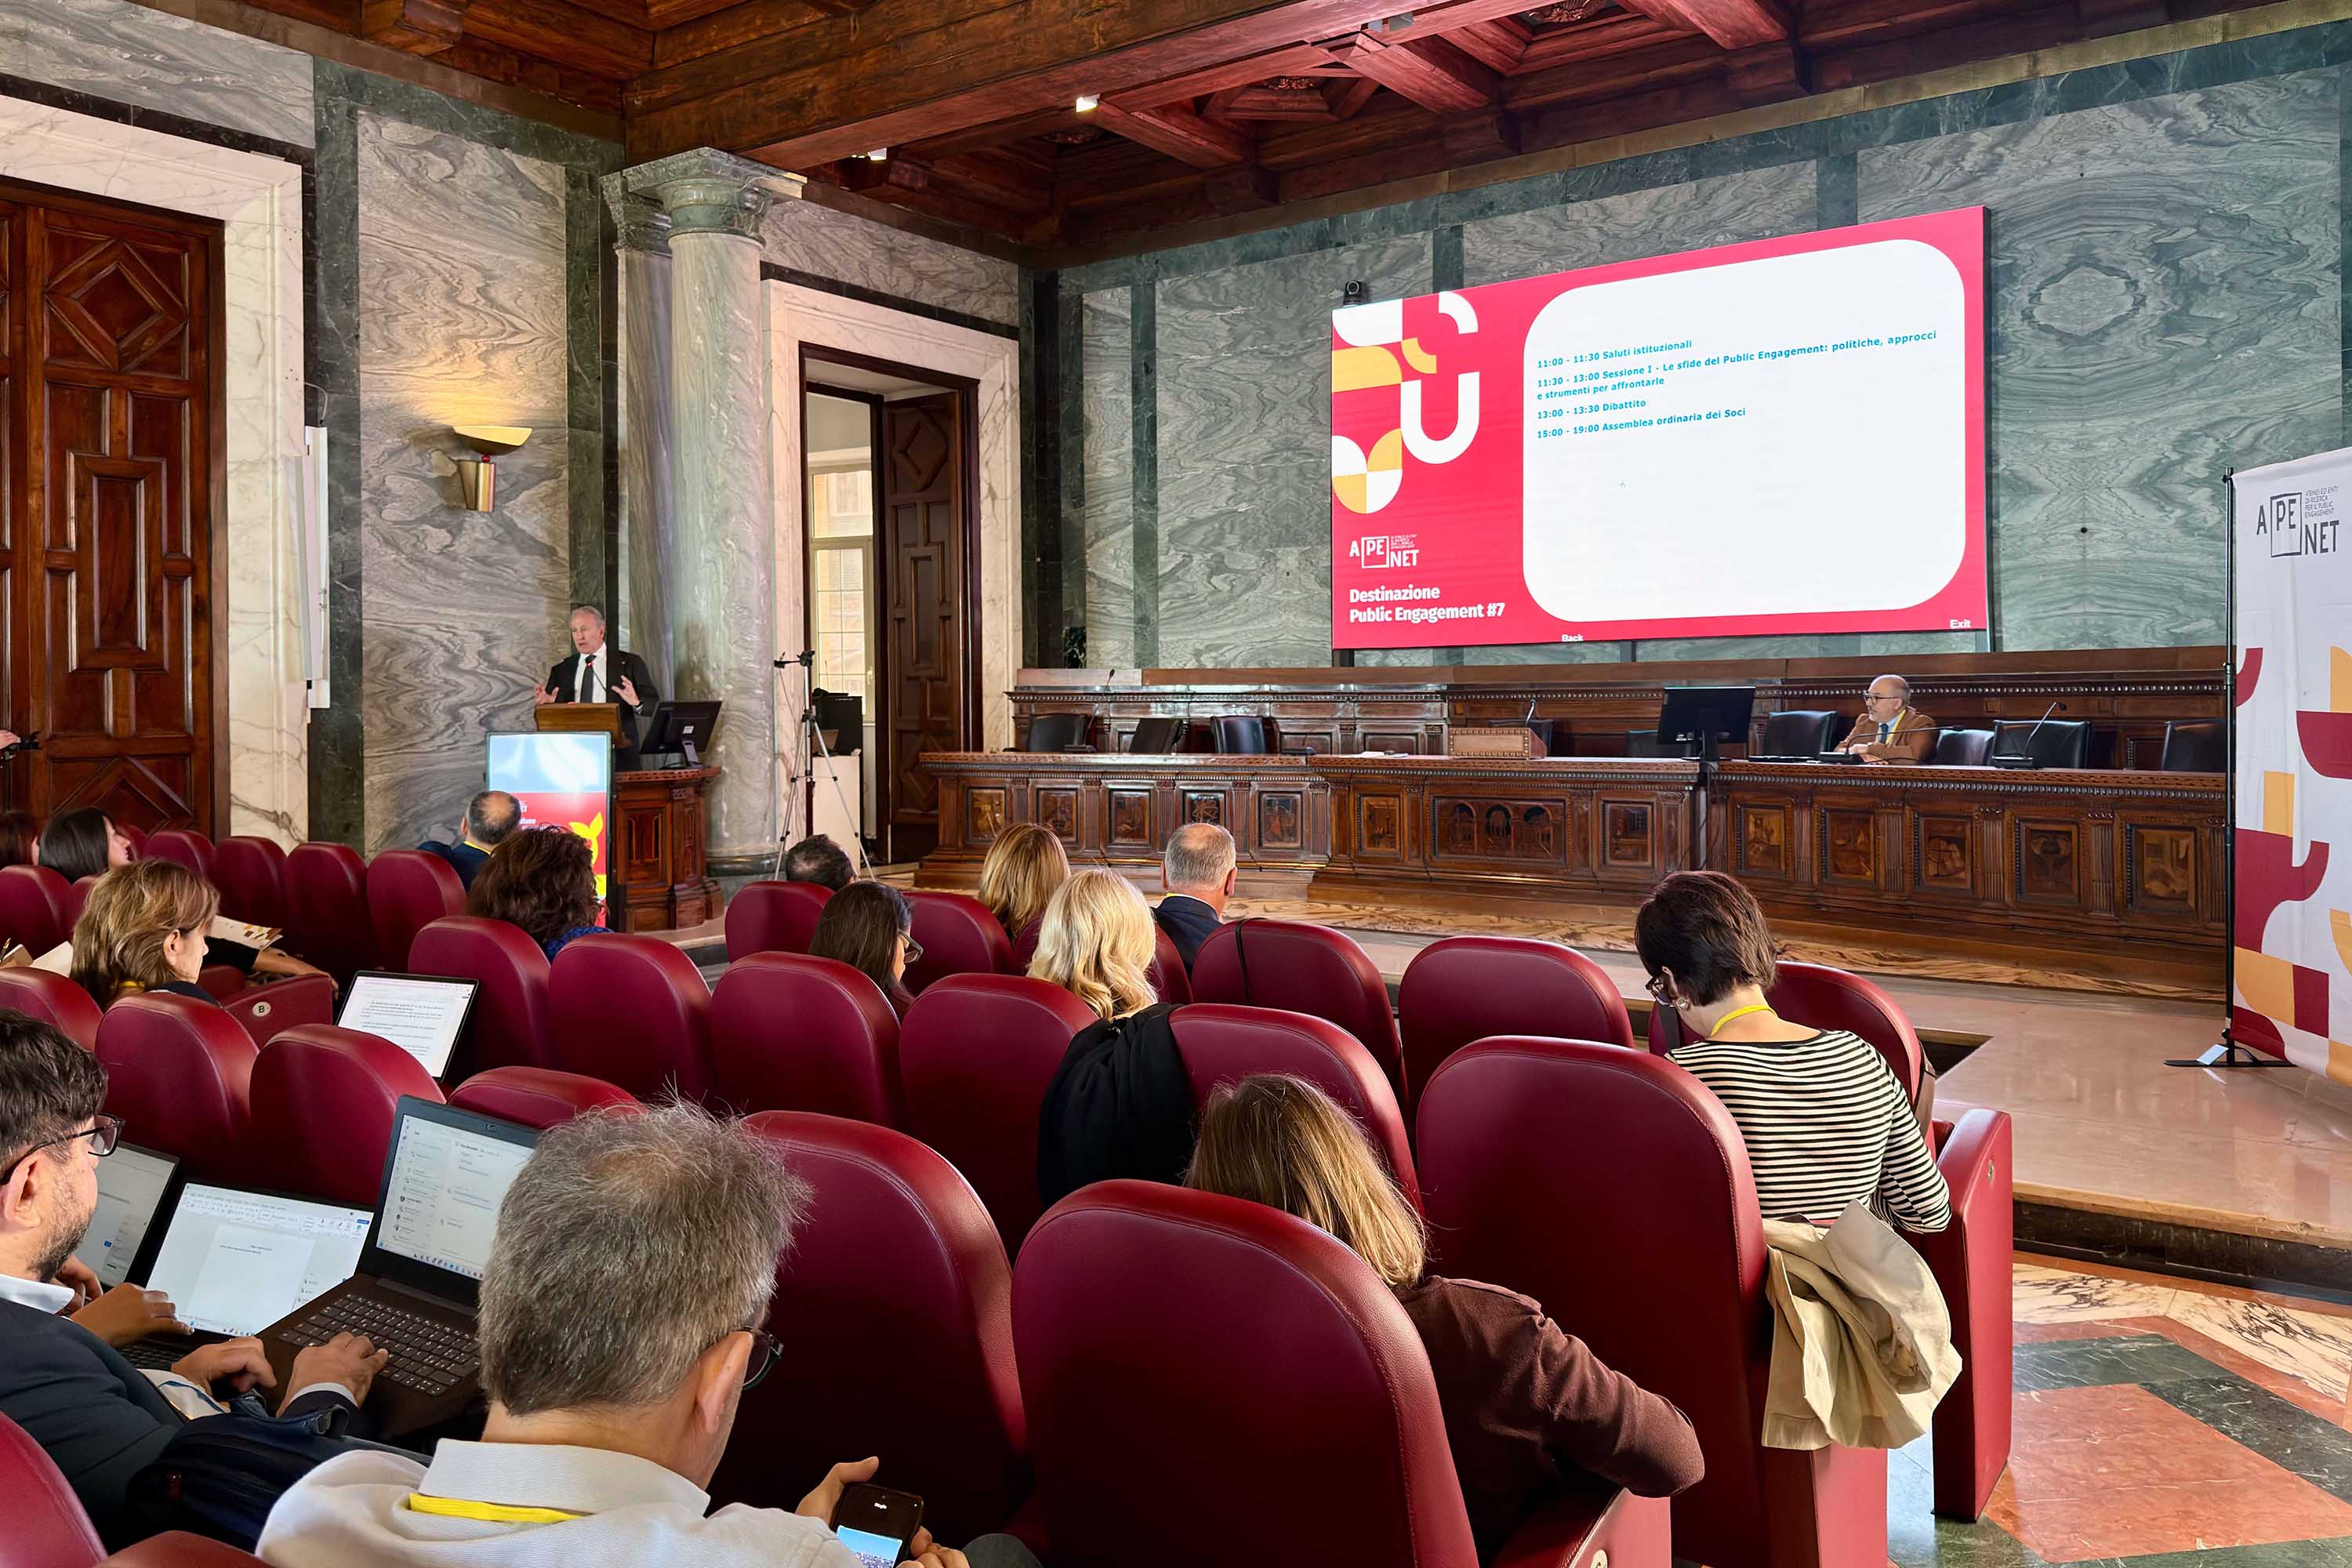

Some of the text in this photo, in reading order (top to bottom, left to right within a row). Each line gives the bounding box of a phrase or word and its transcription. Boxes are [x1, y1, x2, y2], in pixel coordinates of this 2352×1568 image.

[1537, 357, 1564, 368] 11:00
[1573, 352, 1600, 364] 11:30
[1602, 348, 1631, 360] Saluti
[1633, 339, 1693, 355] istituzionali
[1537, 376, 1563, 388] 11:30
[1573, 372, 1600, 383] 13:00
[1602, 367, 1645, 379] Sessione
[1647, 365, 1652, 374] I
[1662, 362, 1675, 372] Le
[1676, 359, 1702, 370] sfide
[1704, 356, 1720, 366] del
[1722, 352, 1755, 365] Public
[1757, 344, 1828, 361] Engagement:
[1831, 338, 1883, 353] politiche,
[1887, 330, 1936, 346] approcci
[1544, 386, 1591, 399] strumenti
[1592, 385, 1609, 395] per
[1611, 376, 1664, 391] affrontarle
[1537, 408, 1564, 419] 13:00
[1573, 404, 1600, 415] 13:30
[1602, 400, 1646, 412] Dibattito
[1537, 427, 1563, 439] 15:00
[1573, 423, 1600, 434] 19:00
[1602, 419, 1653, 431] Assemblea
[1656, 413, 1703, 426] ordinaria
[1705, 409, 1722, 419] dei
[1724, 407, 1746, 418] Soci
[1349, 583, 1441, 603] Destinazione
[1349, 602, 1505, 624] Public Engagement #7
[1950, 619, 1971, 629] Exit
[1561, 633, 1584, 642] Back
[258, 1004, 265, 1014] B
